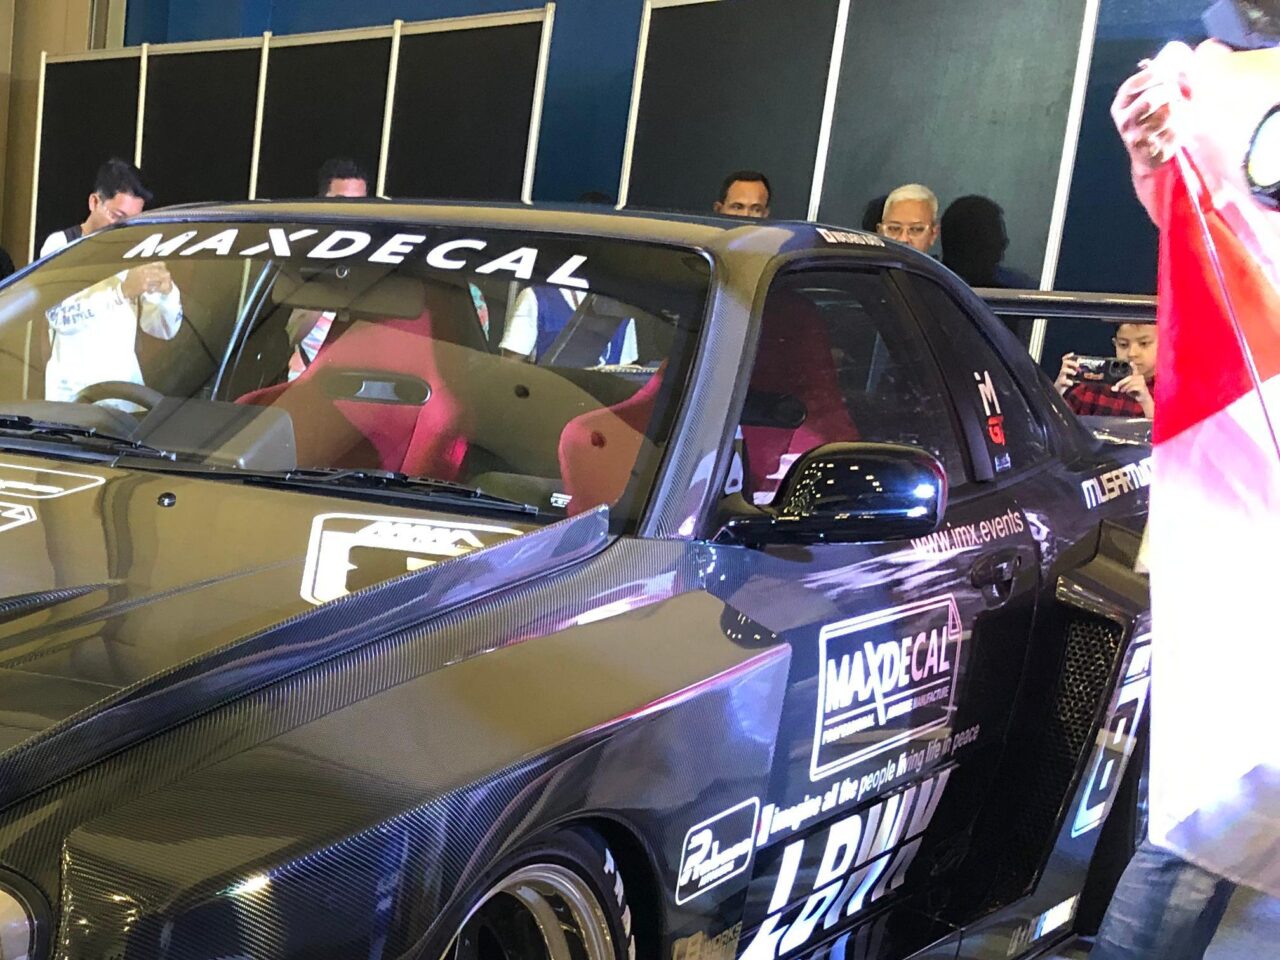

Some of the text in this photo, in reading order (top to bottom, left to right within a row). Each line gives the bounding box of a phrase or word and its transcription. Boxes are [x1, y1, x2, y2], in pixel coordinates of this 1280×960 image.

[123, 229, 590, 289] MAXDECAL
[910, 507, 1024, 554] www.imx.events
[824, 626, 951, 726] MAXDECAL
[856, 759, 895, 802] people
[950, 724, 981, 757] peace
